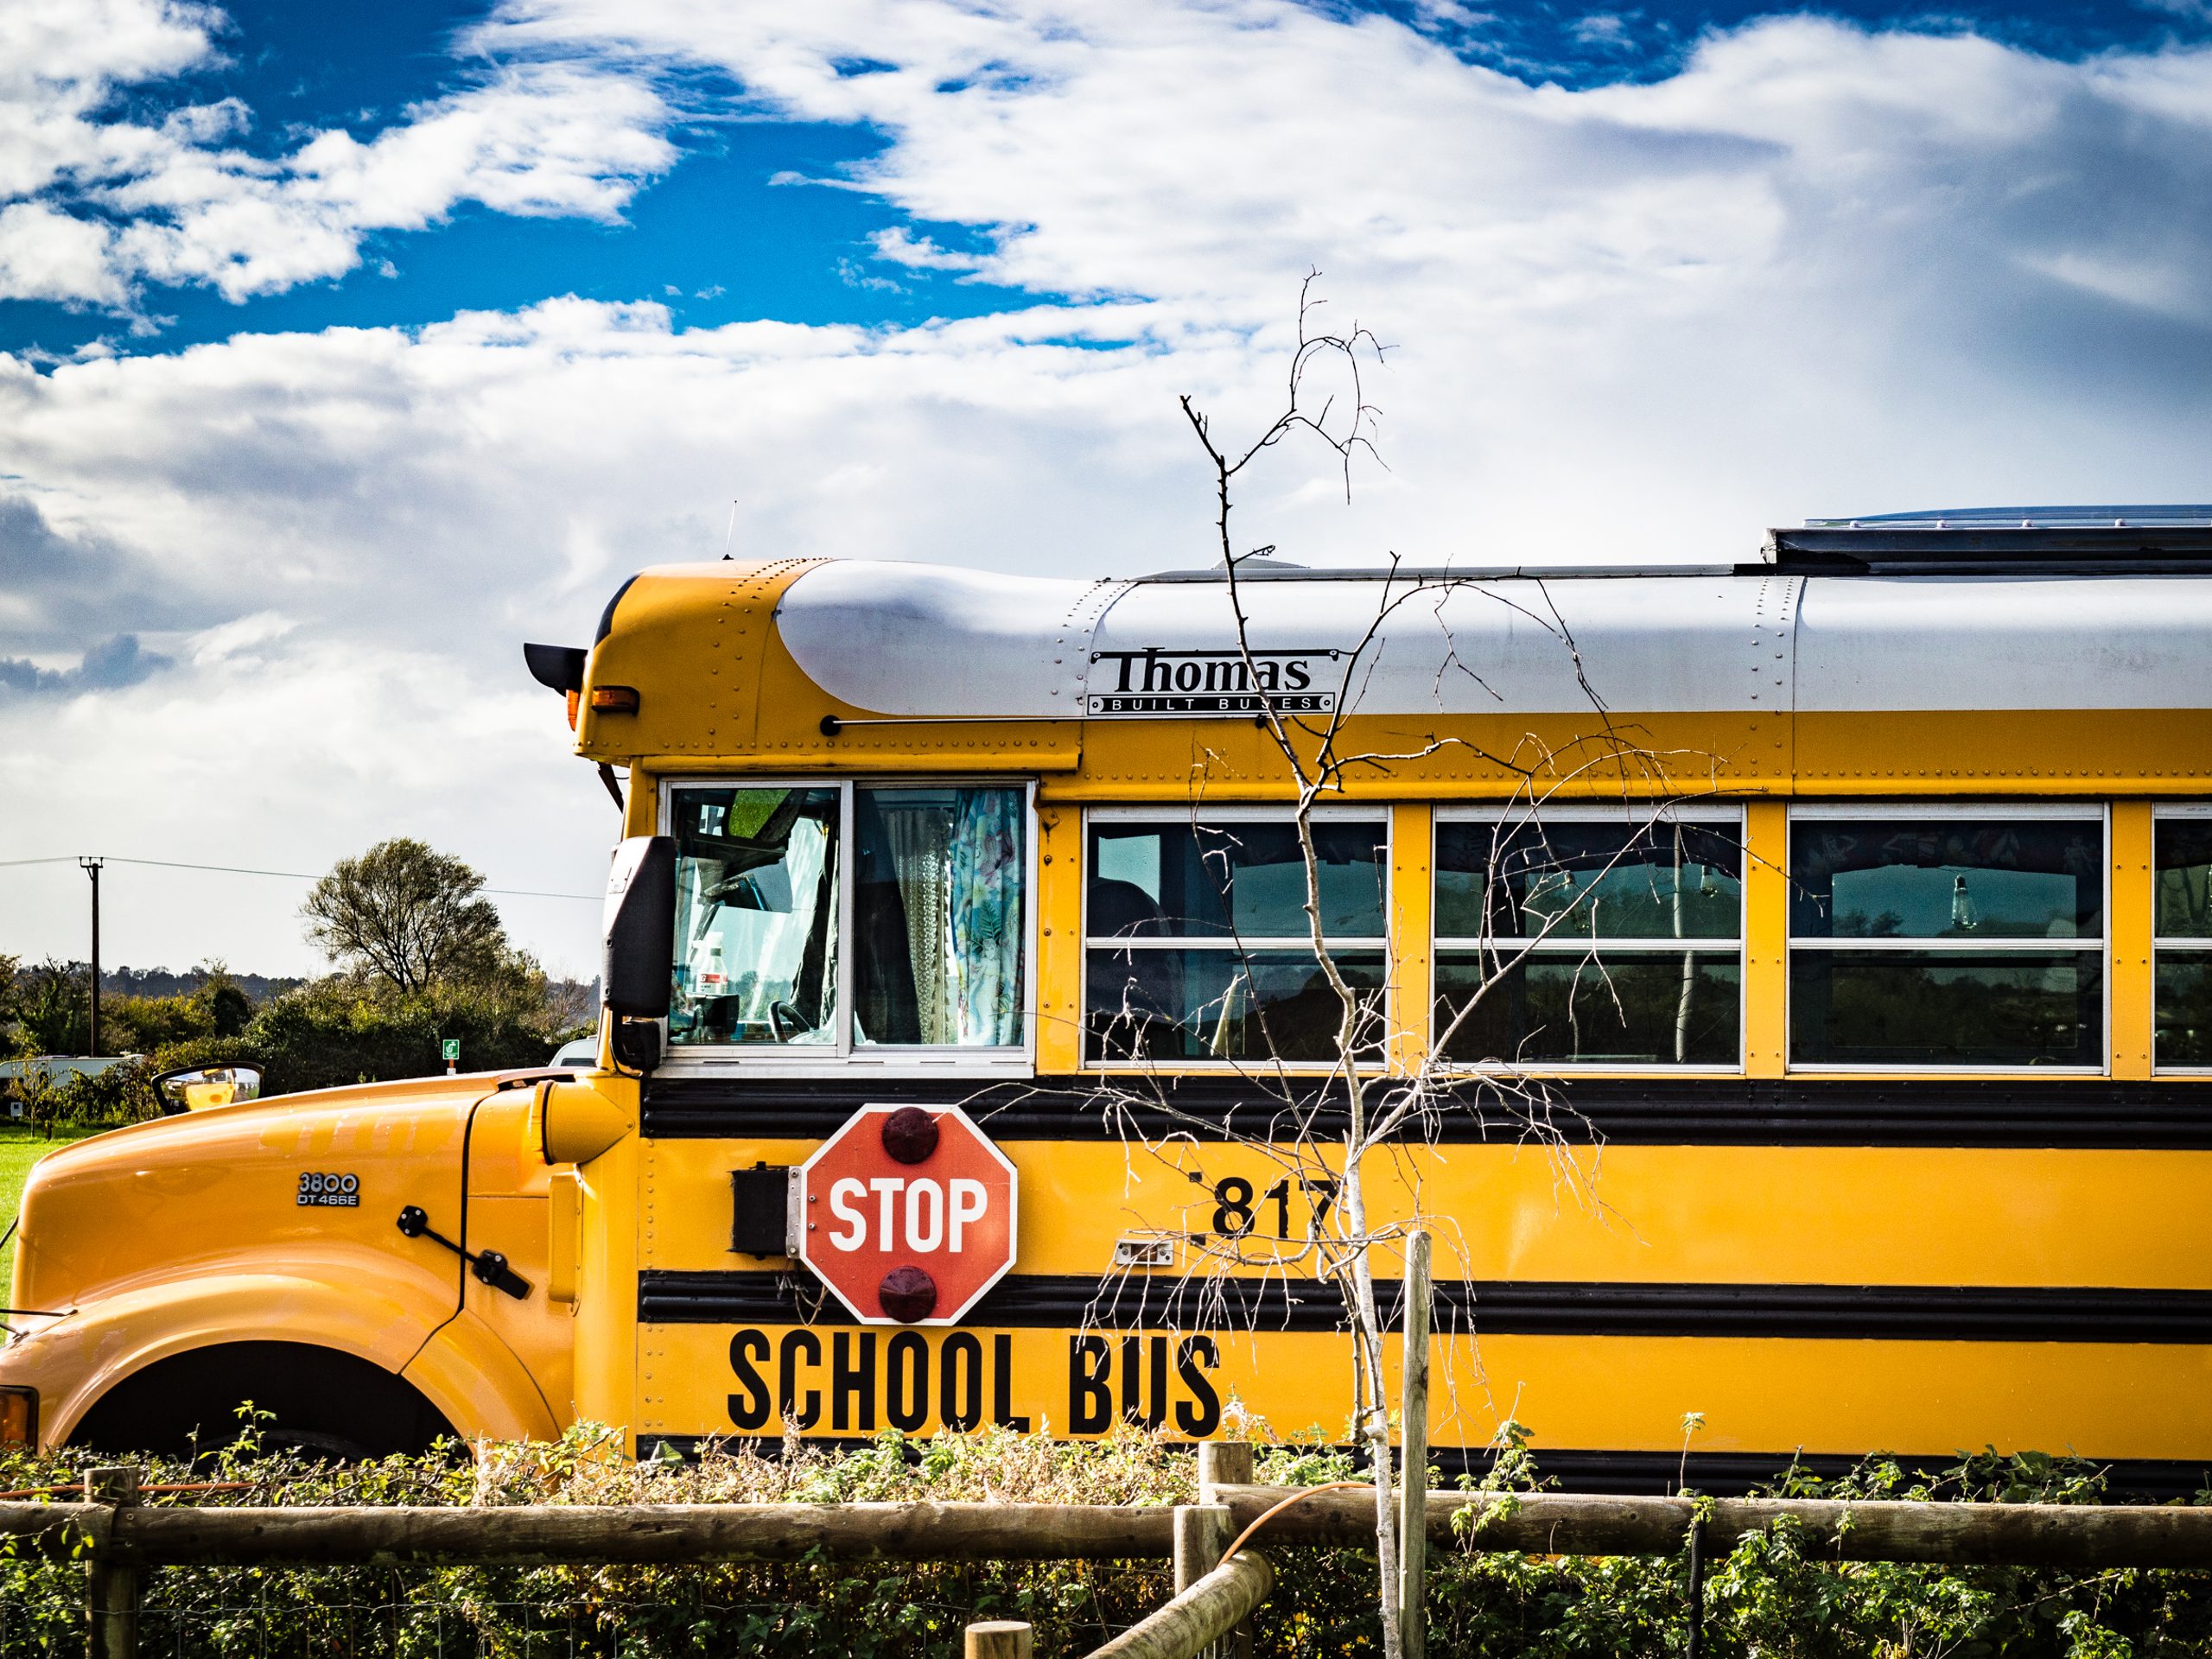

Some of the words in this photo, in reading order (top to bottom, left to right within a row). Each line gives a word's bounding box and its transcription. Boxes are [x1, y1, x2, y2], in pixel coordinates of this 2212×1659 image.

[1113, 646, 1312, 693] Thomas
[1111, 698, 1195, 711] BUILT
[297, 1194, 317, 1205] DT
[318, 1194, 358, 1205] 466E
[298, 1172, 359, 1193] 3800
[828, 1176, 989, 1254] STOP
[1212, 1176, 1342, 1241] 817
[727, 1328, 1031, 1434] SCHOOL
[1068, 1333, 1222, 1438] BUS
